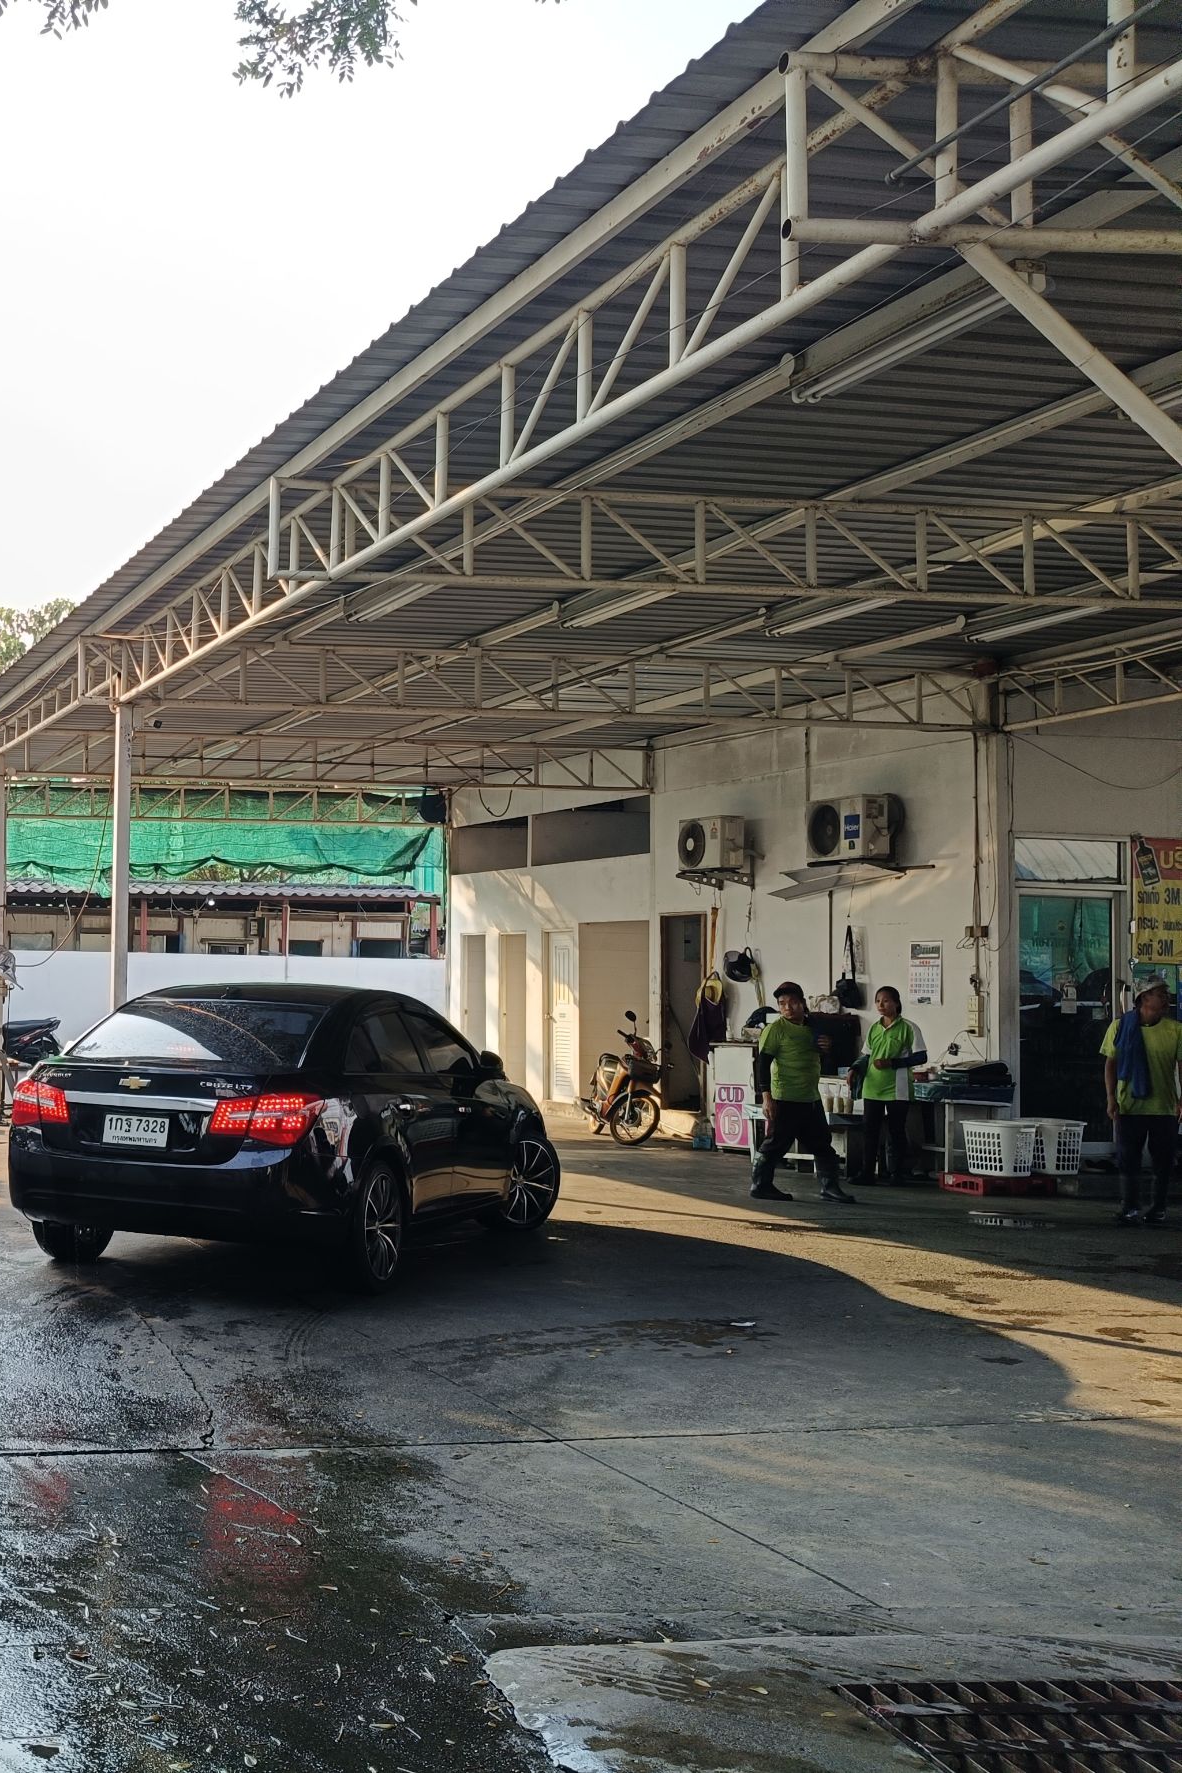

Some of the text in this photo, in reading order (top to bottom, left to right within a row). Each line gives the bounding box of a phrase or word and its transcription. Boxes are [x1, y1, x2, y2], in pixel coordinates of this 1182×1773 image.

[844, 824, 859, 832] Haier
[1164, 887, 1181, 905] 3M
[1137, 915, 1159, 930] กระบะ
[1157, 939, 1174, 957] 3M
[200, 1081, 233, 1089] CRUZE
[717, 1086, 745, 1103] CUD
[108, 1116, 167, 1134] 1กฐ 7328
[722, 1115, 740, 1135] 15
[112, 1135, 157, 1144] กรุงเทพมหานคร
